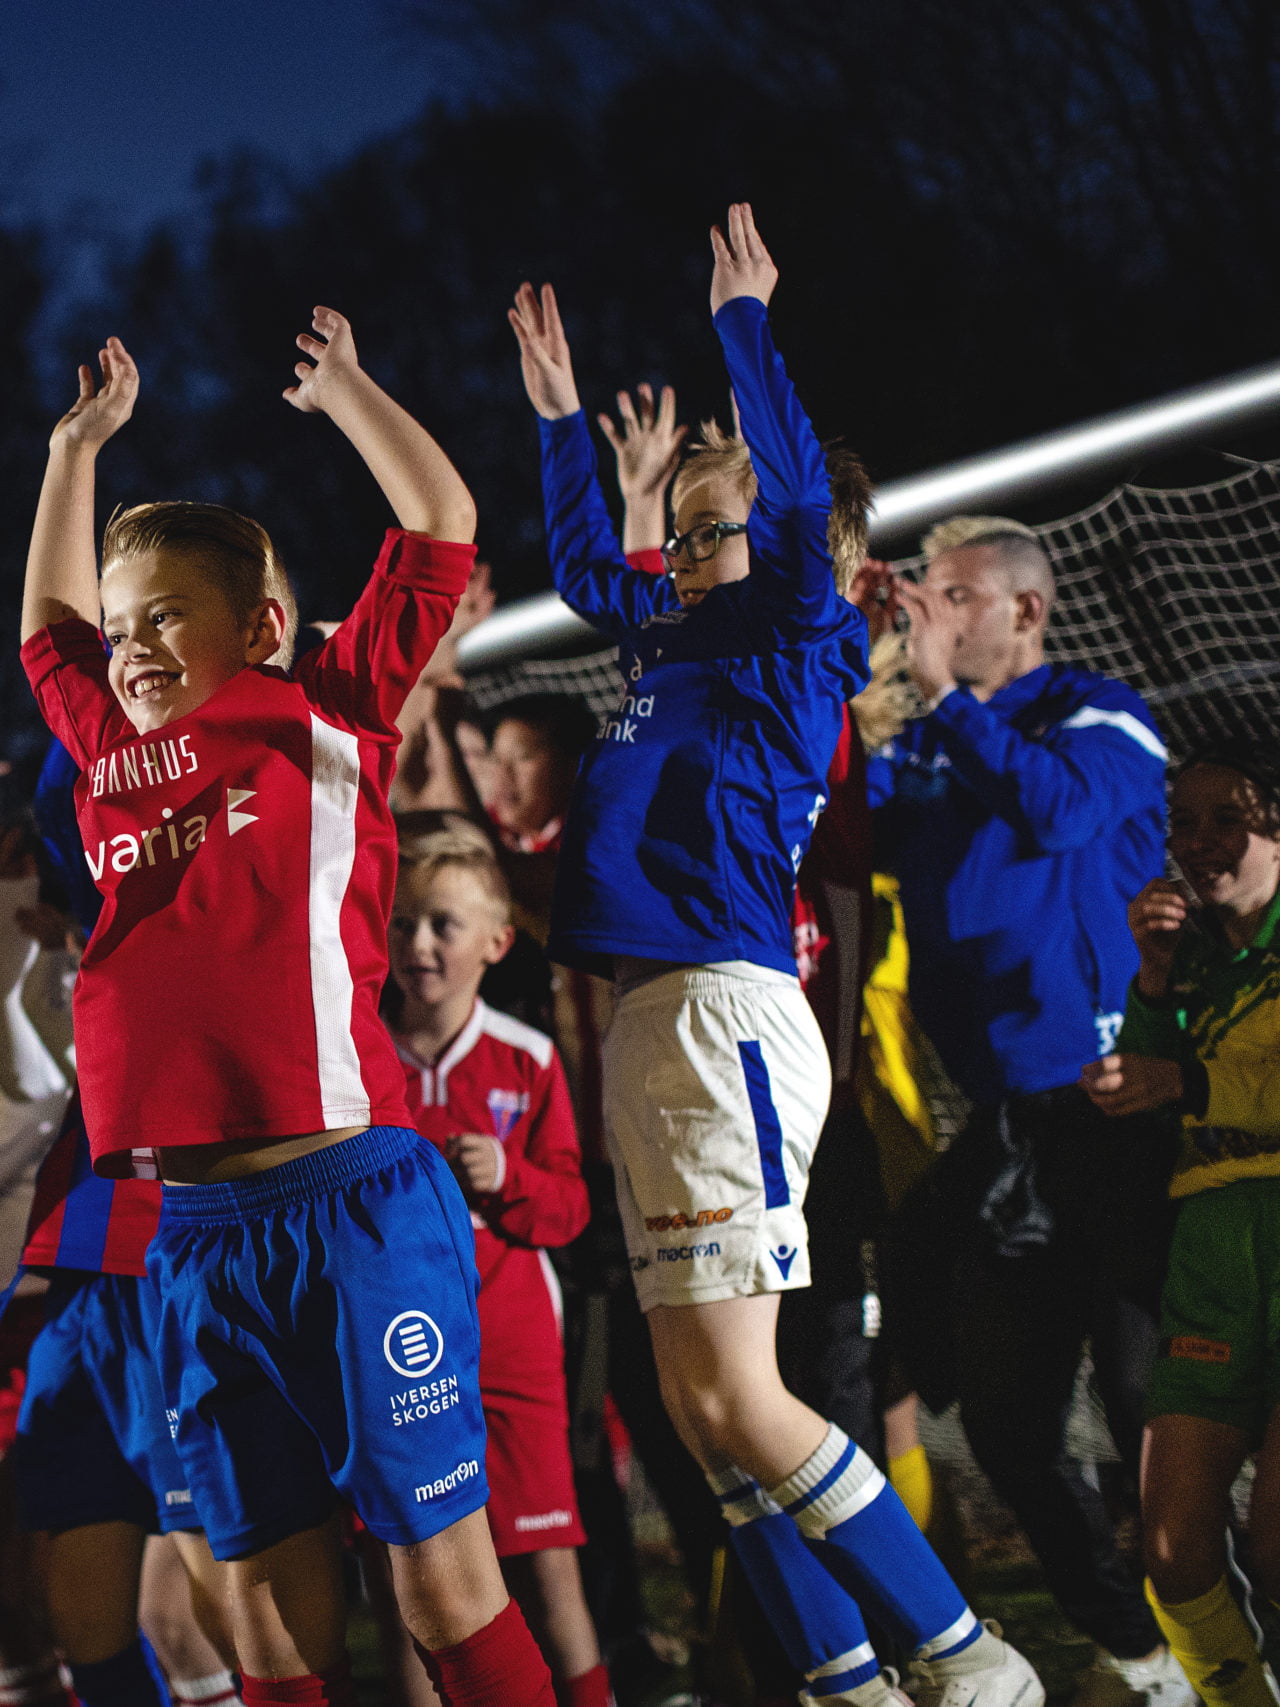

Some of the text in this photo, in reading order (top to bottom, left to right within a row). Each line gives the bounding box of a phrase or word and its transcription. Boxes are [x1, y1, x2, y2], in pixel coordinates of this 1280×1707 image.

[86, 734, 199, 802] BANHUS
[84, 807, 208, 882] varia
[390, 1374, 458, 1410] IVERSEN
[392, 1390, 460, 1427] SKOGEN
[414, 1459, 480, 1503] macron
